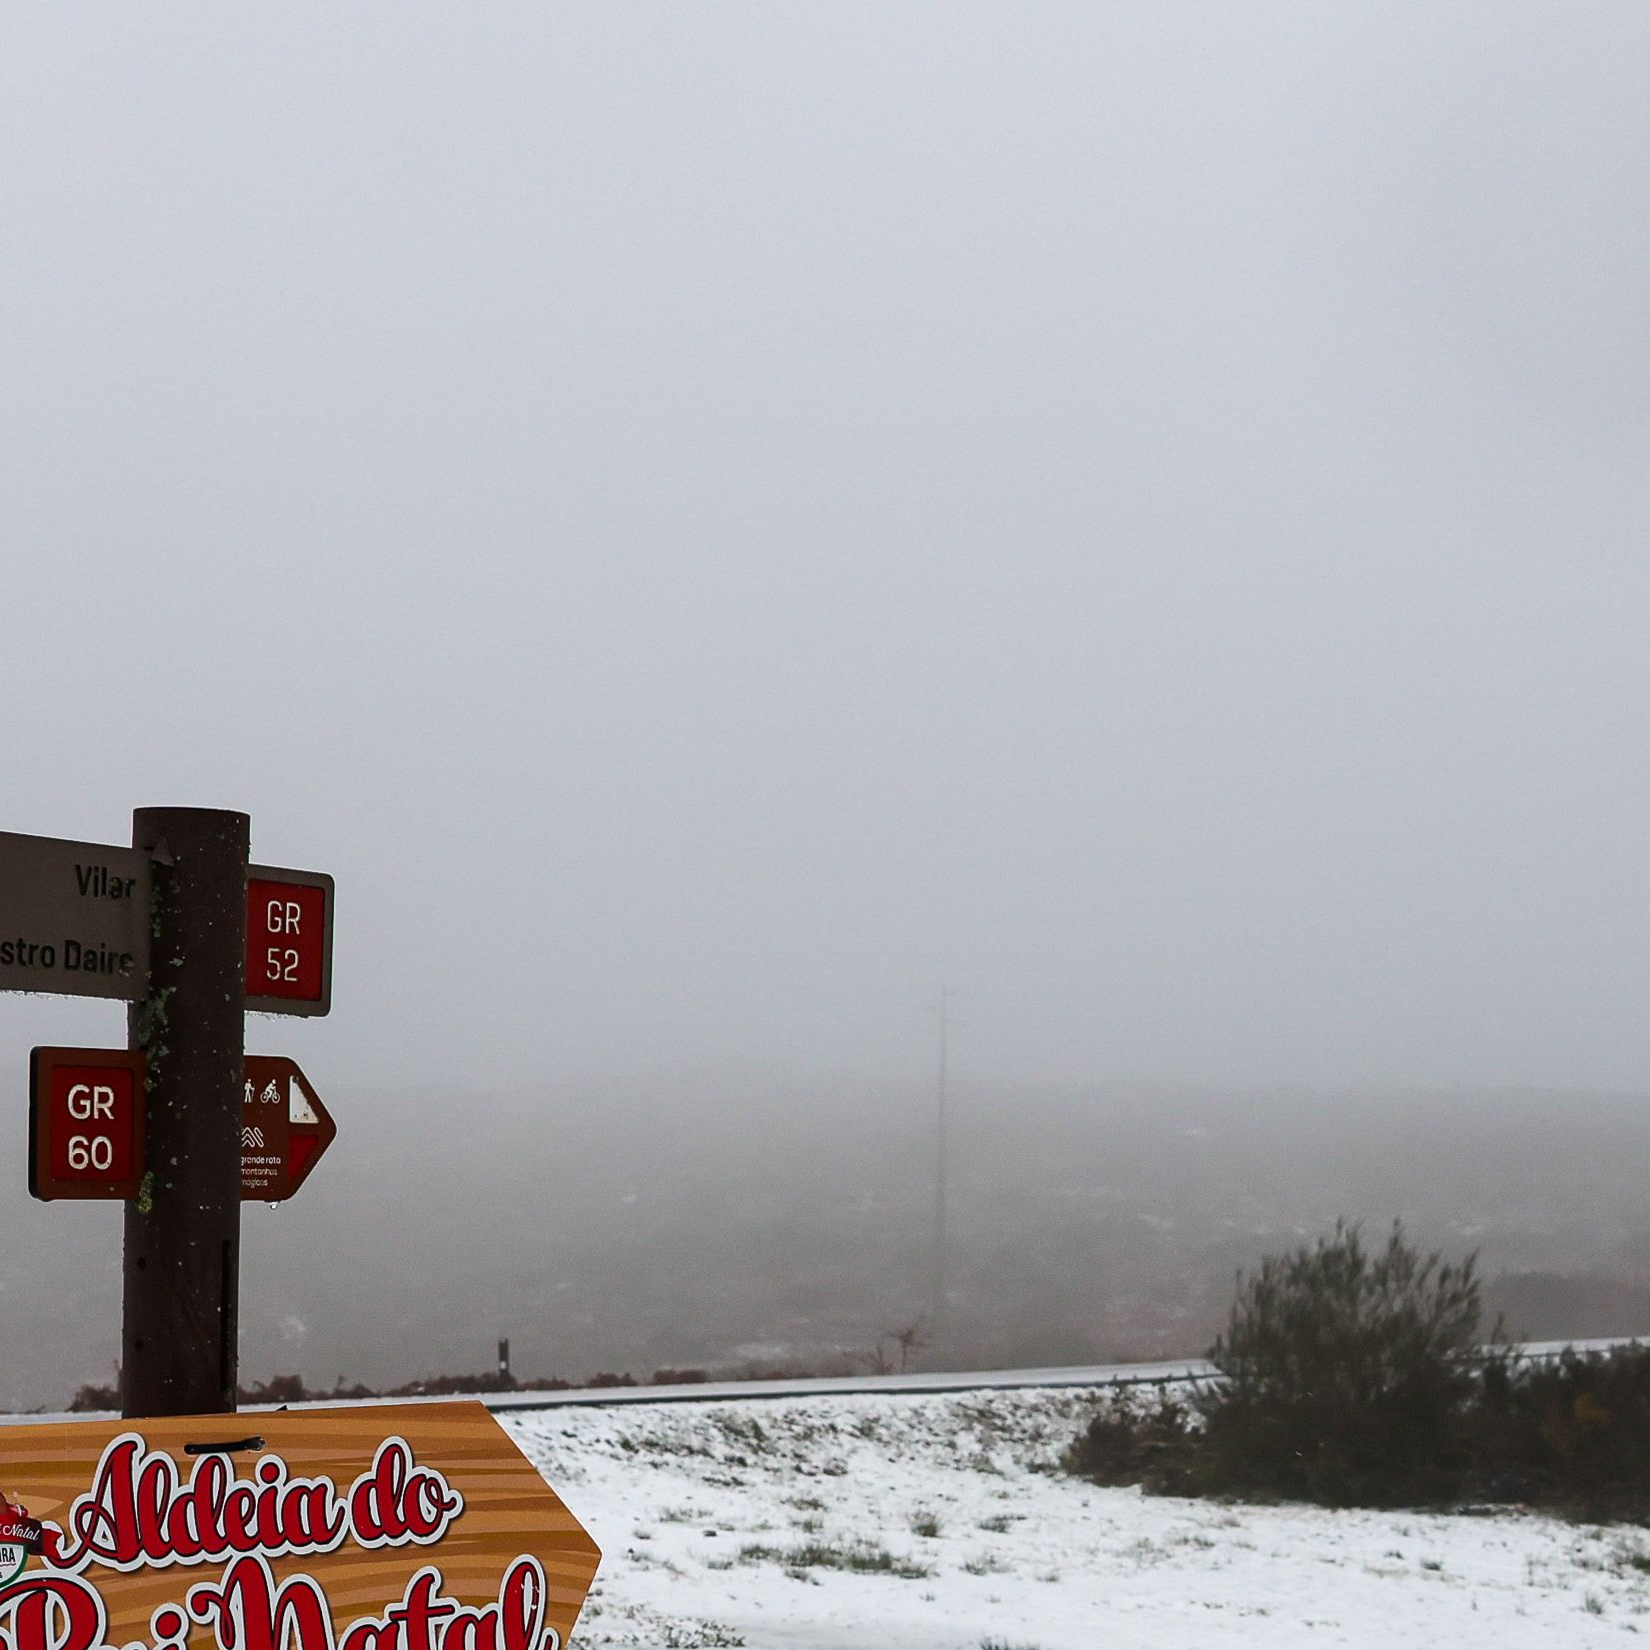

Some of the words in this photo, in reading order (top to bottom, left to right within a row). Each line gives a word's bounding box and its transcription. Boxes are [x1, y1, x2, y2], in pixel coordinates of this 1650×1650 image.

[74, 863, 136, 900] Vilar
[265, 900, 302, 936] GR
[63, 938, 134, 977] Daire
[265, 948, 300, 983] 52
[67, 1084, 116, 1121] GR
[67, 1135, 114, 1171] 60
[265, 1156, 281, 1164] rota
[53, 1438, 346, 1568] Aldeia
[352, 1440, 461, 1545] do
[2, 1523, 41, 1541] Natal
